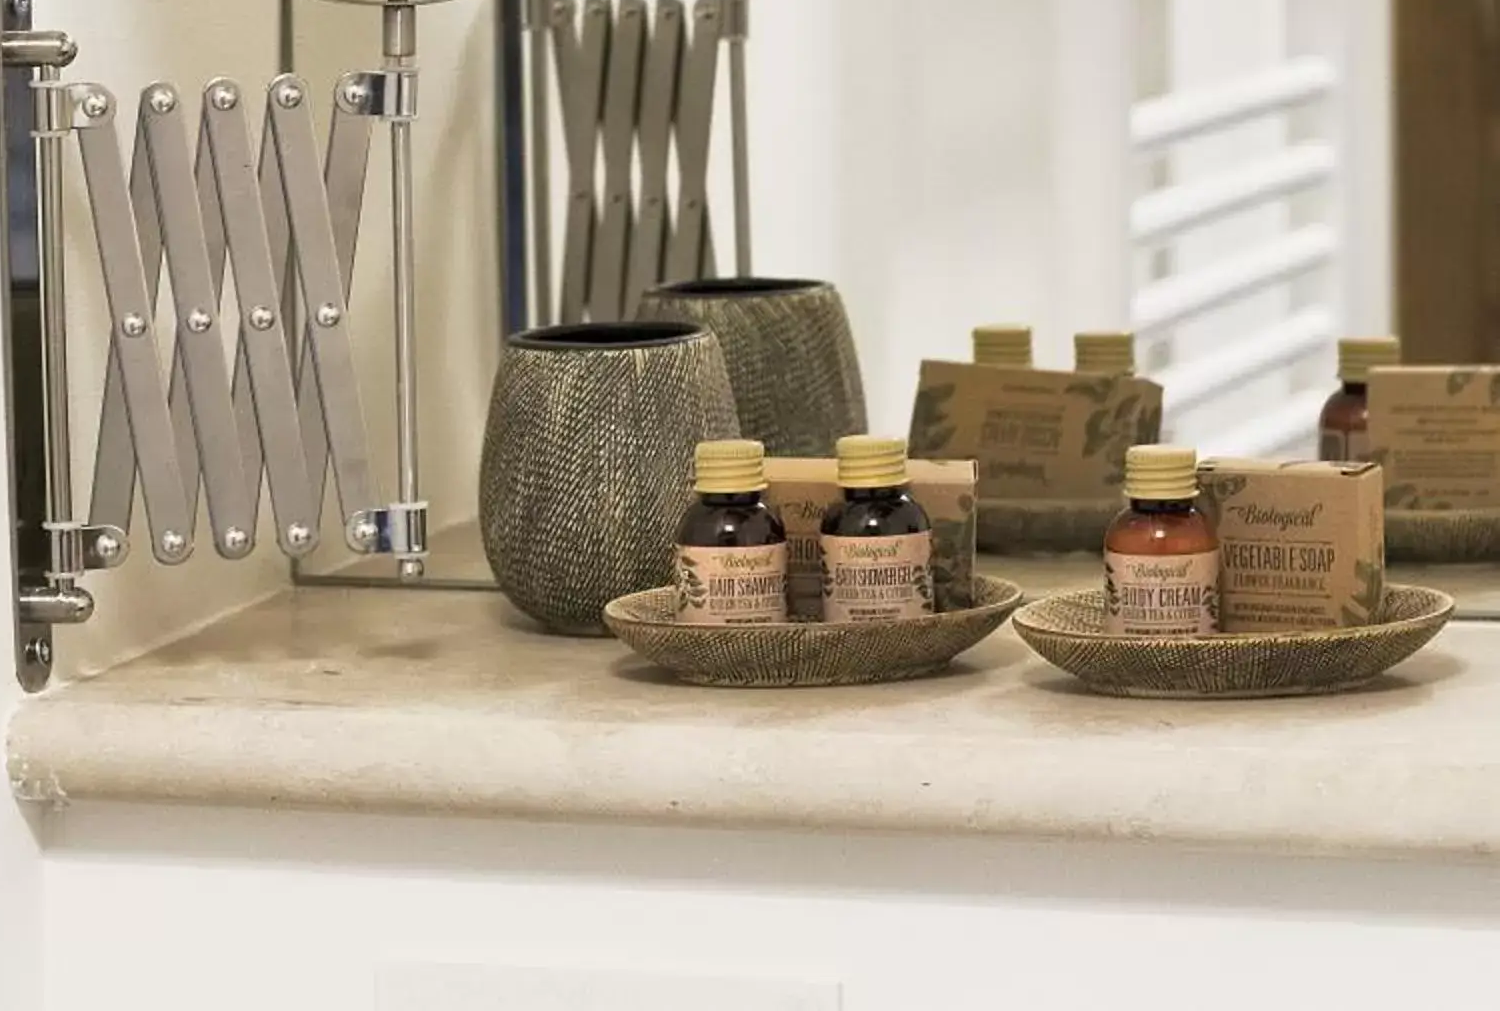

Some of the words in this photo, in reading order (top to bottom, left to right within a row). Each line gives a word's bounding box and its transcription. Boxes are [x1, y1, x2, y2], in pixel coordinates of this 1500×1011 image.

[1227, 501, 1323, 531] Biological
[1223, 543, 1297, 572] VEGETABLE
[1299, 547, 1336, 573] SOAP
[709, 577, 735, 598] HAIR
[1122, 586, 1156, 607] BODY
[1159, 586, 1201, 607] CREAM
